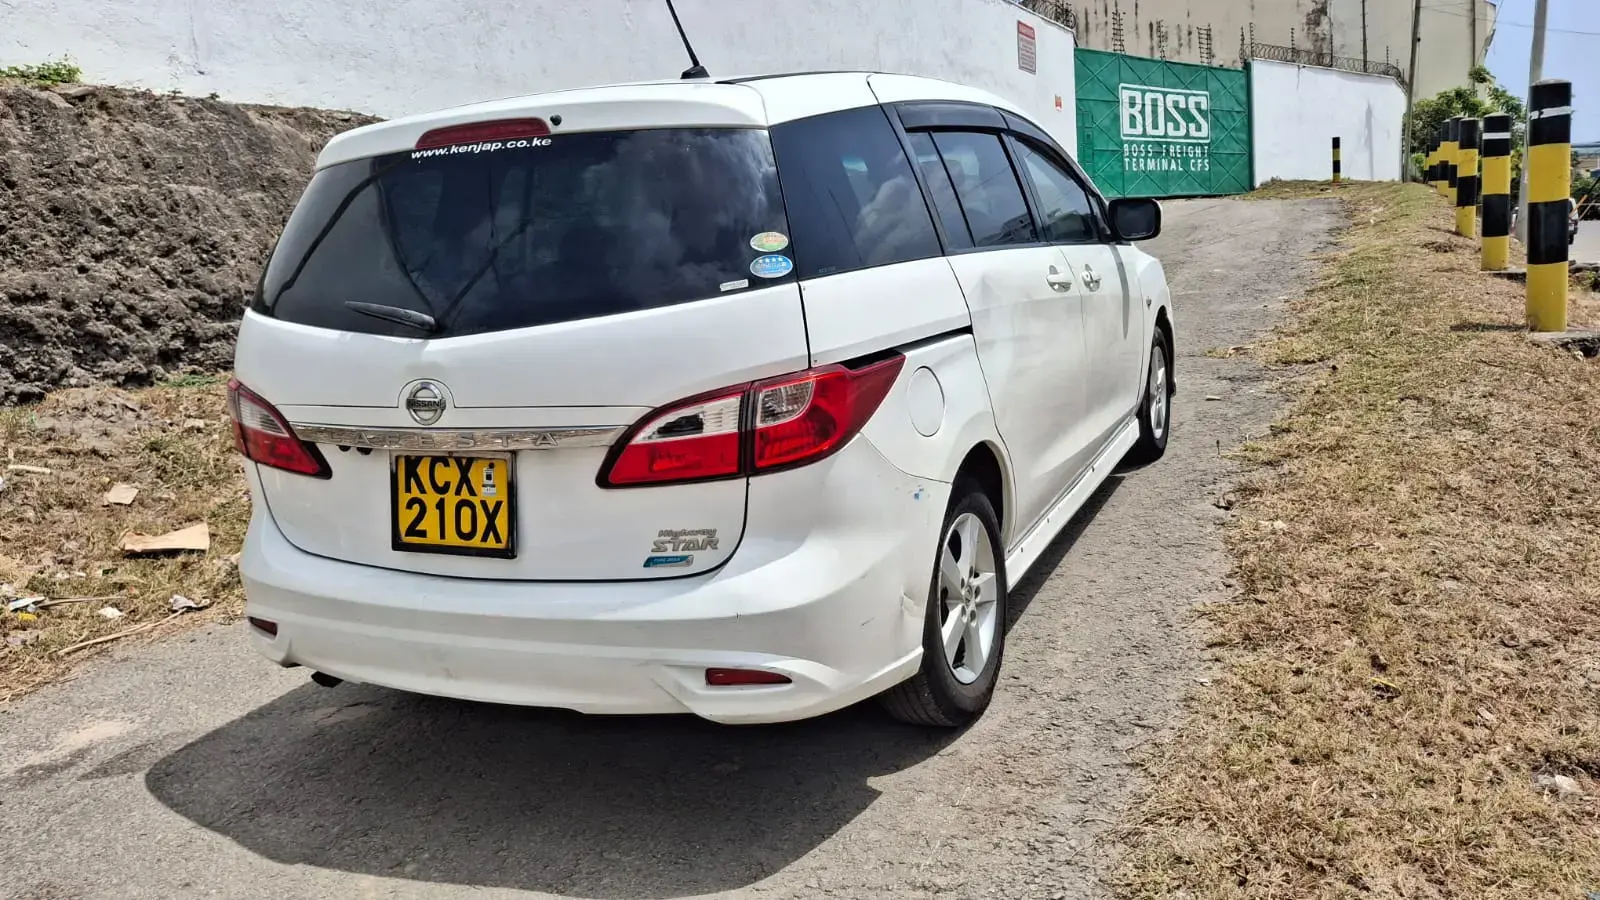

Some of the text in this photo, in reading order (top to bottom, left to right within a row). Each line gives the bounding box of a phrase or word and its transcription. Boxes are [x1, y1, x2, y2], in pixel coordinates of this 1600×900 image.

[1121, 89, 1208, 138] BOSS
[411, 137, 552, 159] www.kenjap.co.ke
[1124, 144, 1209, 158] BOSS FREIGHT
[1124, 158, 1209, 171] TERMINAL CFS
[409, 399, 440, 408] NISSAN
[404, 455, 477, 496] KCX
[404, 497, 504, 544] 210X
[651, 538, 719, 552] STAR
